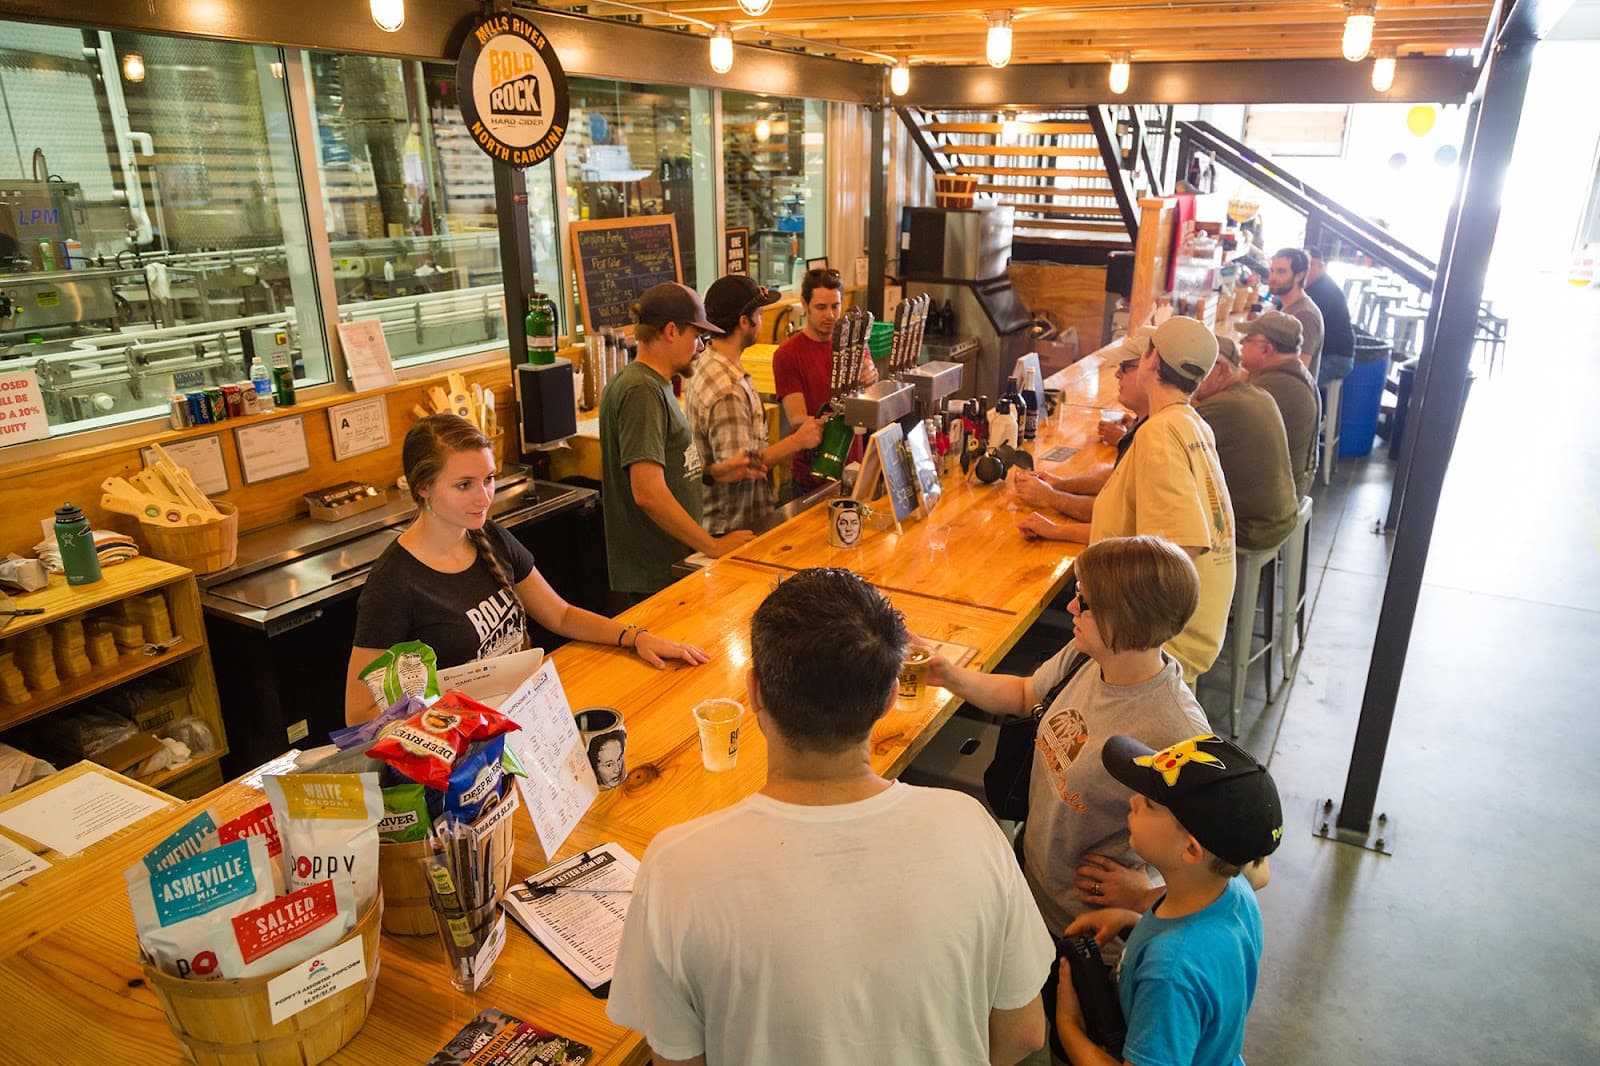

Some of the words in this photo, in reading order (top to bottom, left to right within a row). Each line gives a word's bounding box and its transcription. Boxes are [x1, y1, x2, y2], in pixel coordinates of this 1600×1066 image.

[474, 15, 509, 44] MILLS
[512, 18, 546, 50] RIVER
[488, 48, 535, 88] BOLD
[491, 78, 540, 112] ROCK
[490, 118, 516, 126] HARD
[472, 121, 510, 161] NORTH
[513, 125, 564, 164] CAROLINA
[18, 208, 59, 226] LPM
[14, 394, 28, 404] BE
[9, 410, 17, 419] A
[18, 406, 40, 417] 20%
[341, 418, 350, 430] A
[465, 589, 514, 644] BOLD
[422, 741, 454, 760] DEEP
[303, 783, 343, 800] WHITE
[463, 782, 485, 803] DEEP
[303, 798, 350, 807] CHEDDAR
[378, 813, 416, 828] RIVER
[163, 857, 244, 903] ASHEVILLE
[197, 887, 219, 901] MIX
[256, 896, 315, 935] SALTED
[261, 911, 317, 942] CARAMEL
[332, 959, 361, 978] POPCORN
[469, 1032, 493, 1055] ROCK
[473, 1035, 509, 1066] BIRTHDAY
